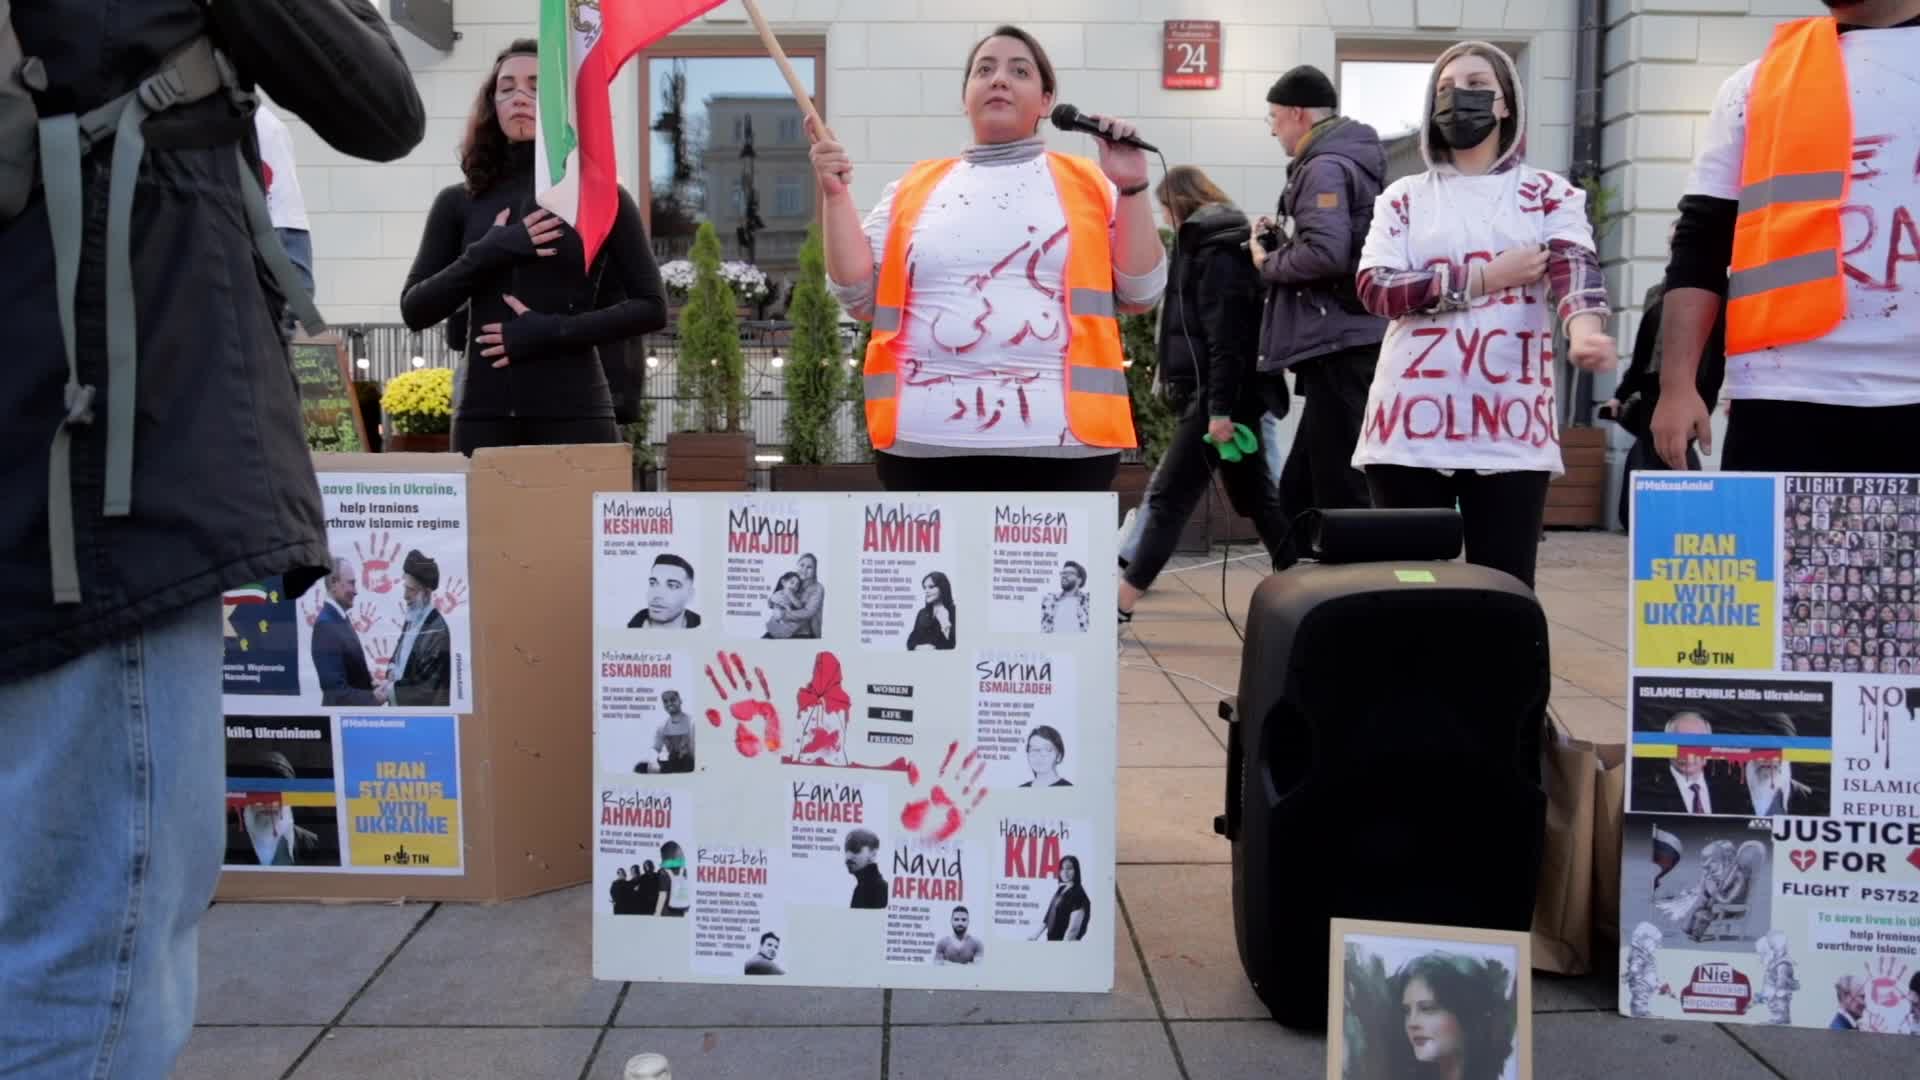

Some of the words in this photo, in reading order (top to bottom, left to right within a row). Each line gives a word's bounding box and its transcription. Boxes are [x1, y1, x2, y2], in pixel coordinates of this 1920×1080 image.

[1176, 43, 1207, 72] 24
[323, 484, 352, 495] save
[356, 483, 386, 495] lives
[389, 483, 400, 495] in
[403, 483, 457, 496] Ukraine,
[1785, 479, 1844, 494] FLIGHT
[1853, 478, 1909, 494] PS752
[340, 502, 366, 515] help
[369, 502, 419, 513] Iranians
[603, 500, 672, 518] Mahmoud
[864, 503, 941, 527] Mahsa
[995, 505, 1068, 526] Mohsen
[326, 518, 365, 529] rthrow
[369, 518, 414, 529] Islamic
[417, 518, 460, 530] regime
[603, 518, 673, 535] KESHVARI
[729, 505, 799, 536] Minou
[728, 532, 799, 555] MAJIDI
[863, 520, 941, 552] AMINI
[994, 525, 1068, 544] MOUSAVI
[1674, 533, 1737, 556] IRAN
[1651, 558, 1757, 581] STANDS
[1674, 584, 1736, 603] WITH
[1643, 603, 1761, 626] UKRAINE
[601, 663, 672, 678] ESKANDARI
[976, 660, 1053, 682] Sarina
[873, 686, 909, 695] WOMEN
[979, 680, 1052, 695] ESMAILZADEH
[1639, 686, 1683, 699] ISLAMIC
[1685, 687, 1736, 700] REPUBLIC
[1738, 688, 1762, 701] kills
[1764, 689, 1825, 702] Ukrainians
[881, 710, 901, 720] LIFE
[227, 726, 252, 739] kills
[255, 726, 322, 740] Ukrainians
[870, 735, 913, 744] FREEDOM
[376, 761, 426, 779] IRAN
[1845, 758, 1871, 771] TO
[359, 780, 443, 799] STANDS
[793, 781, 863, 806] Kan'an
[378, 801, 427, 817] WITH
[601, 807, 671, 829] AHMADI
[792, 801, 863, 824] AGHAEE
[355, 816, 448, 835] UKRAINE
[1774, 819, 1920, 846] JUSTICE
[697, 849, 767, 865] Rouzbeh
[893, 845, 962, 879] Navid
[1004, 834, 1062, 879] KIA
[1823, 851, 1887, 873] FOR
[696, 866, 767, 885] KHADEMI
[892, 876, 963, 901] AFKARI
[1782, 882, 1849, 899] FLIGHT
[1861, 887, 1919, 904] PS752
[1819, 912, 1832, 923] To
[1835, 914, 1862, 925] save
[1866, 914, 1893, 926] lives
[1896, 916, 1907, 926] in
[1850, 929, 1874, 942] help
[1817, 942, 1873, 953] overthrow
[1876, 944, 1917, 955] Islamic
[1701, 966, 1730, 982] Nie
